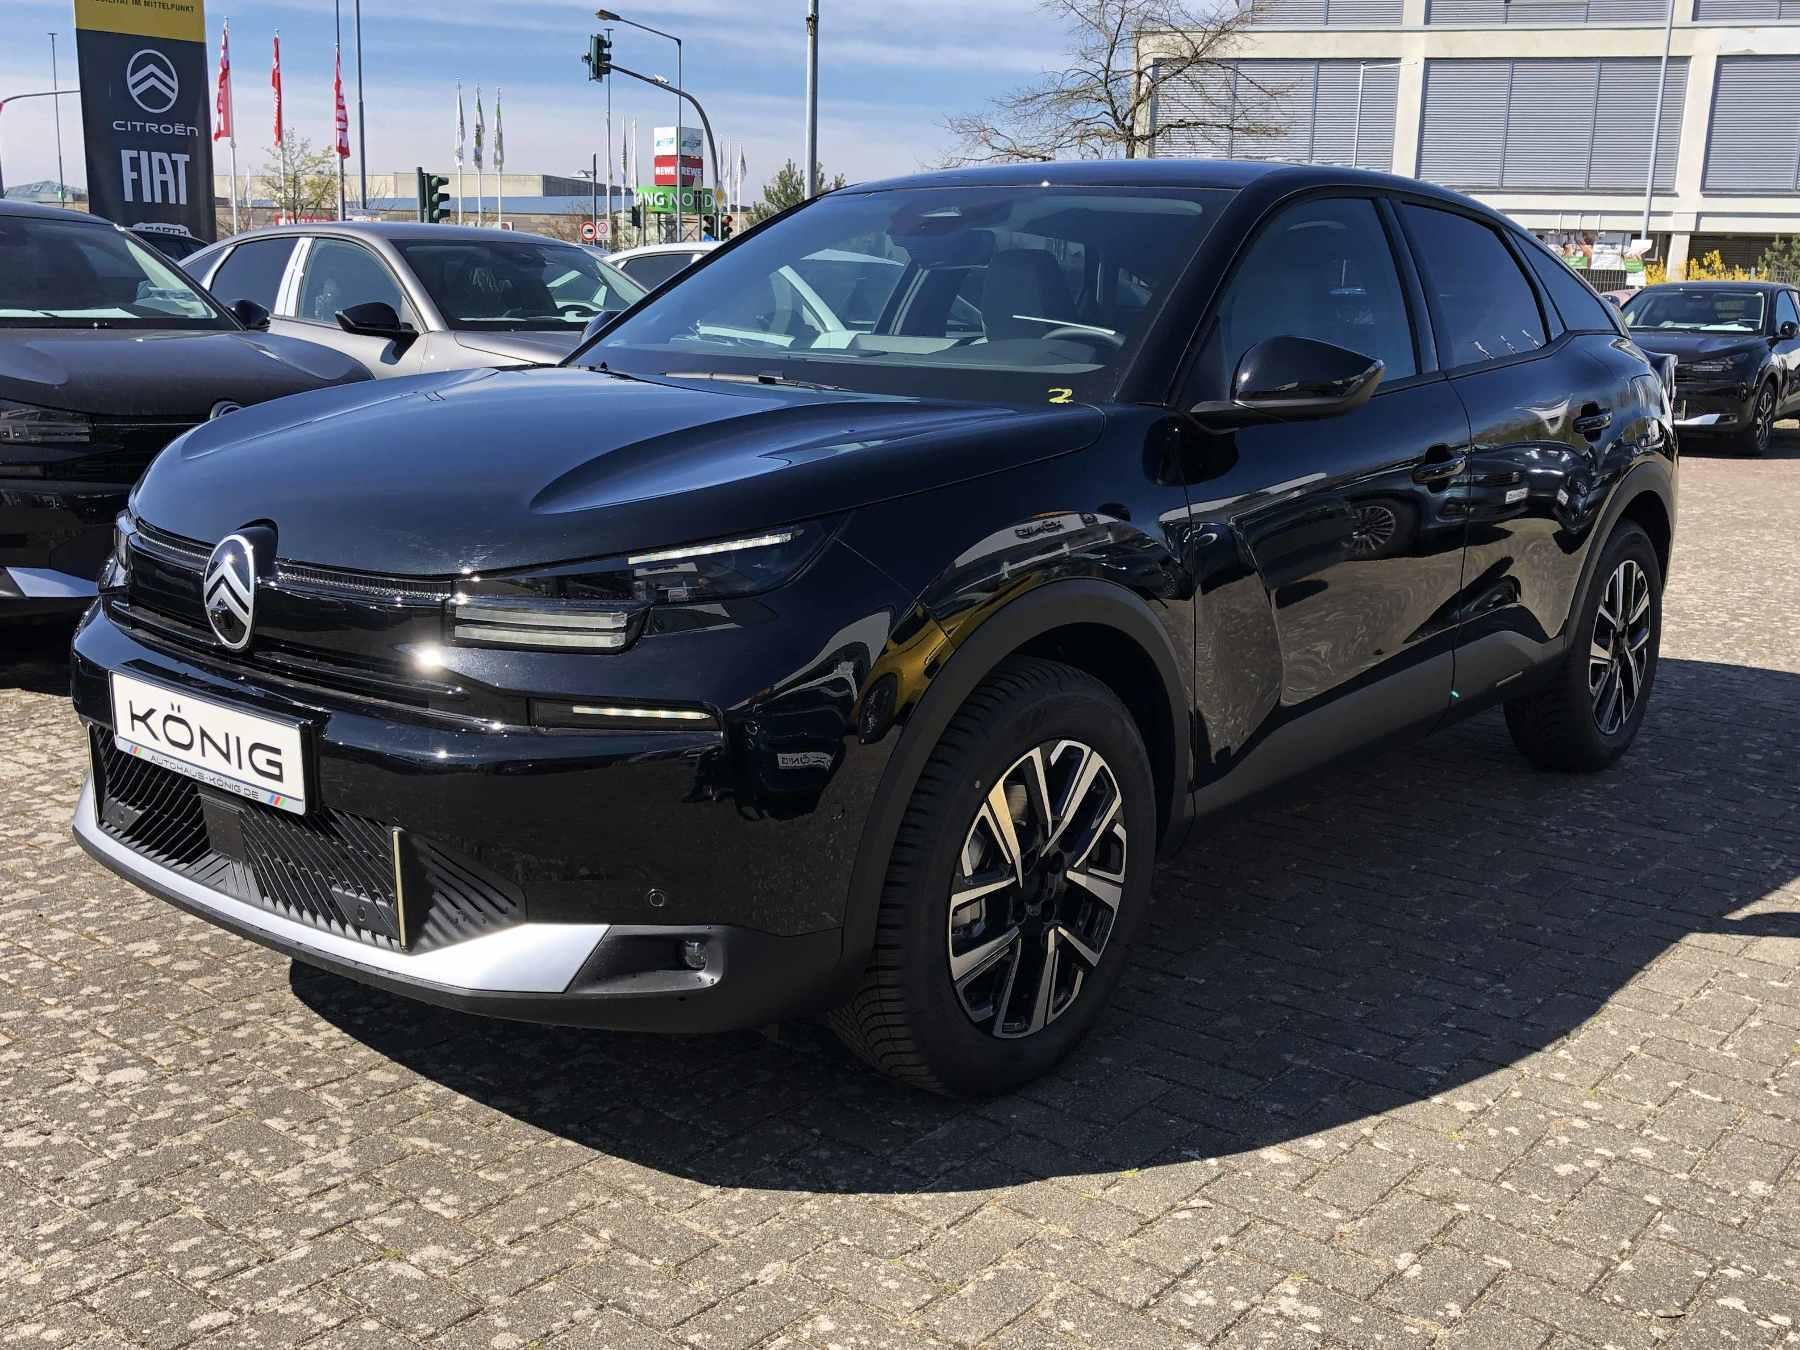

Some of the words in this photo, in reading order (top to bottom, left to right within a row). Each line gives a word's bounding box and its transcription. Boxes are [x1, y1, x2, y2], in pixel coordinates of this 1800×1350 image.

[120, 149, 190, 206] FIAT
[655, 166, 676, 176] REWE
[681, 167, 703, 177] REWE
[669, 192, 713, 208] NOD
[1048, 388, 1074, 404] 2
[128, 699, 284, 785] KÖNIG
